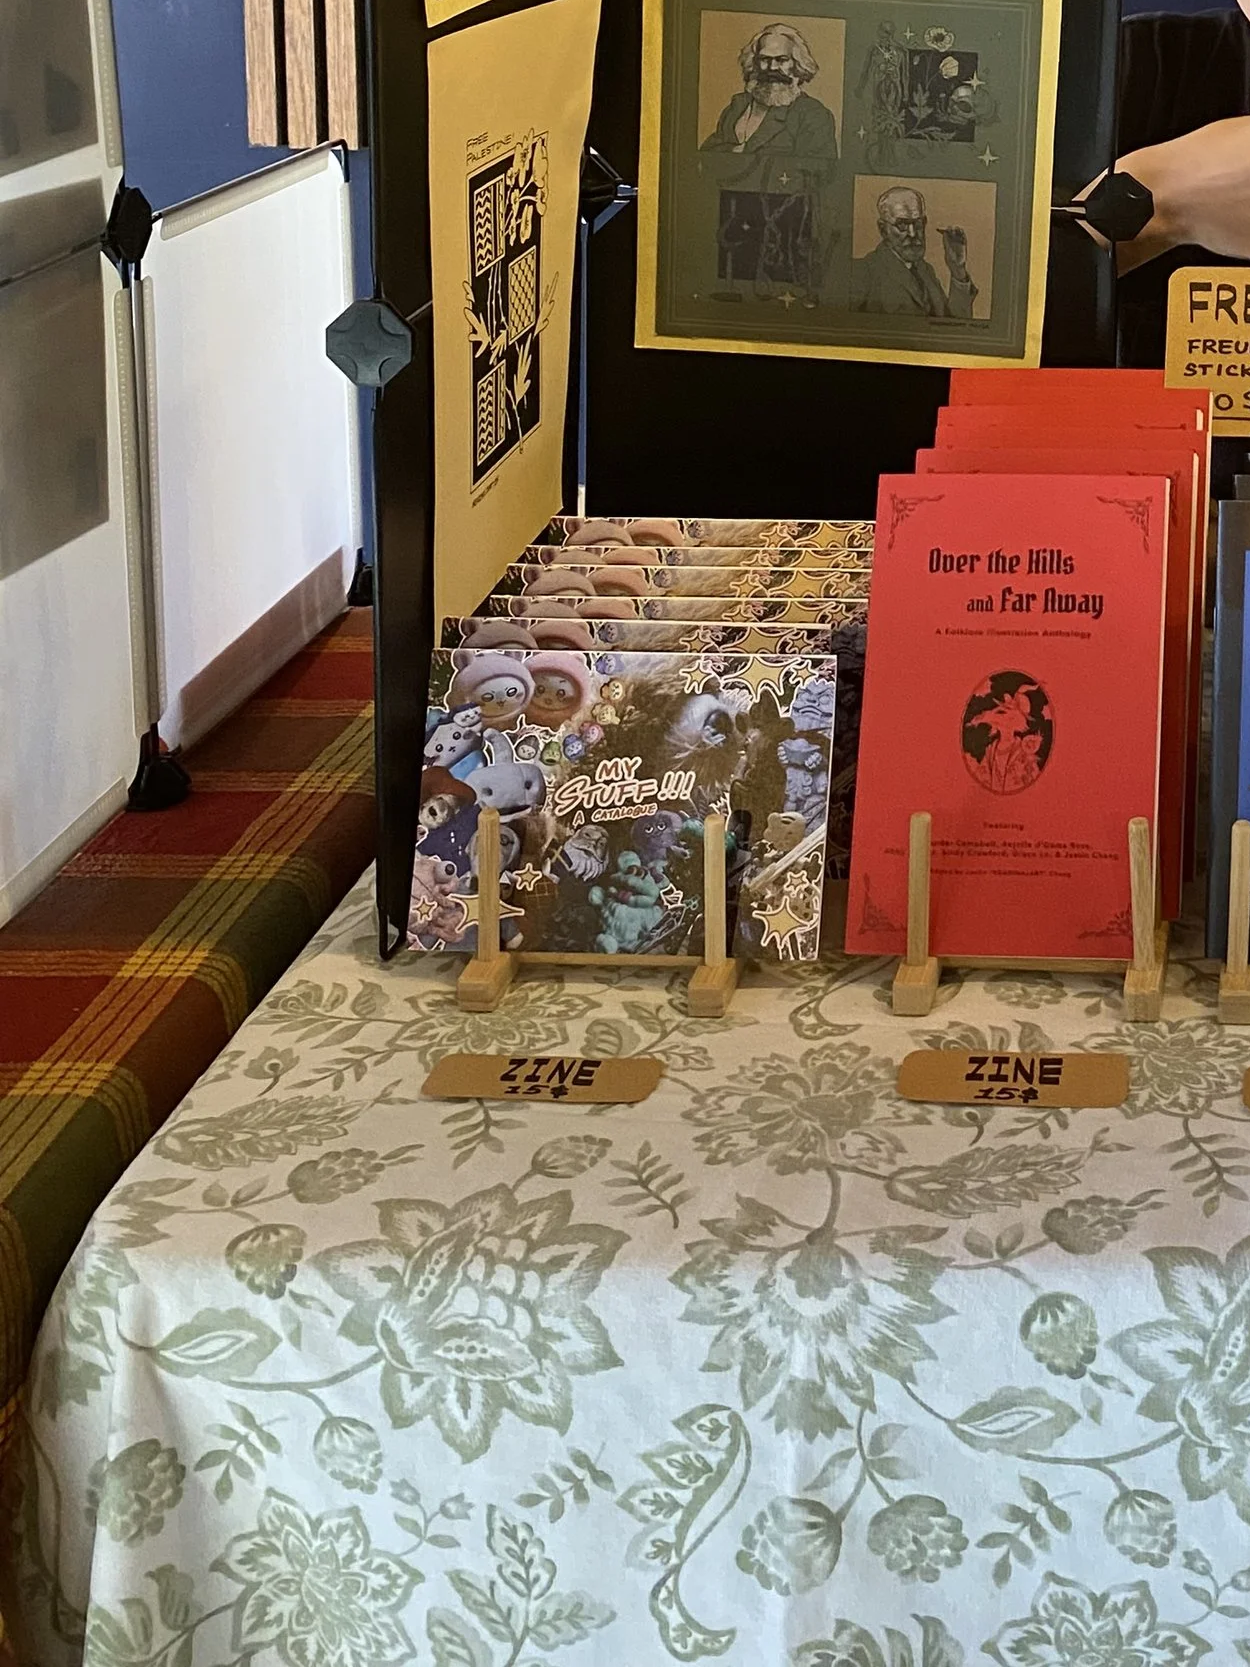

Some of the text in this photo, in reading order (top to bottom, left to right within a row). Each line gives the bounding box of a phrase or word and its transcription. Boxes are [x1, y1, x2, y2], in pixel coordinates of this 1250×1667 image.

[929, 547, 1075, 575] Over the Hills
[967, 586, 1104, 619] and Far Away
[596, 757, 642, 781] MY
[556, 772, 695, 815] STUFF!!!
[573, 804, 658, 825] A CATALOGUE
[500, 1058, 601, 1086] ZINE
[965, 1056, 1064, 1085] ZINE
[973, 1087, 1039, 1103] 15$
